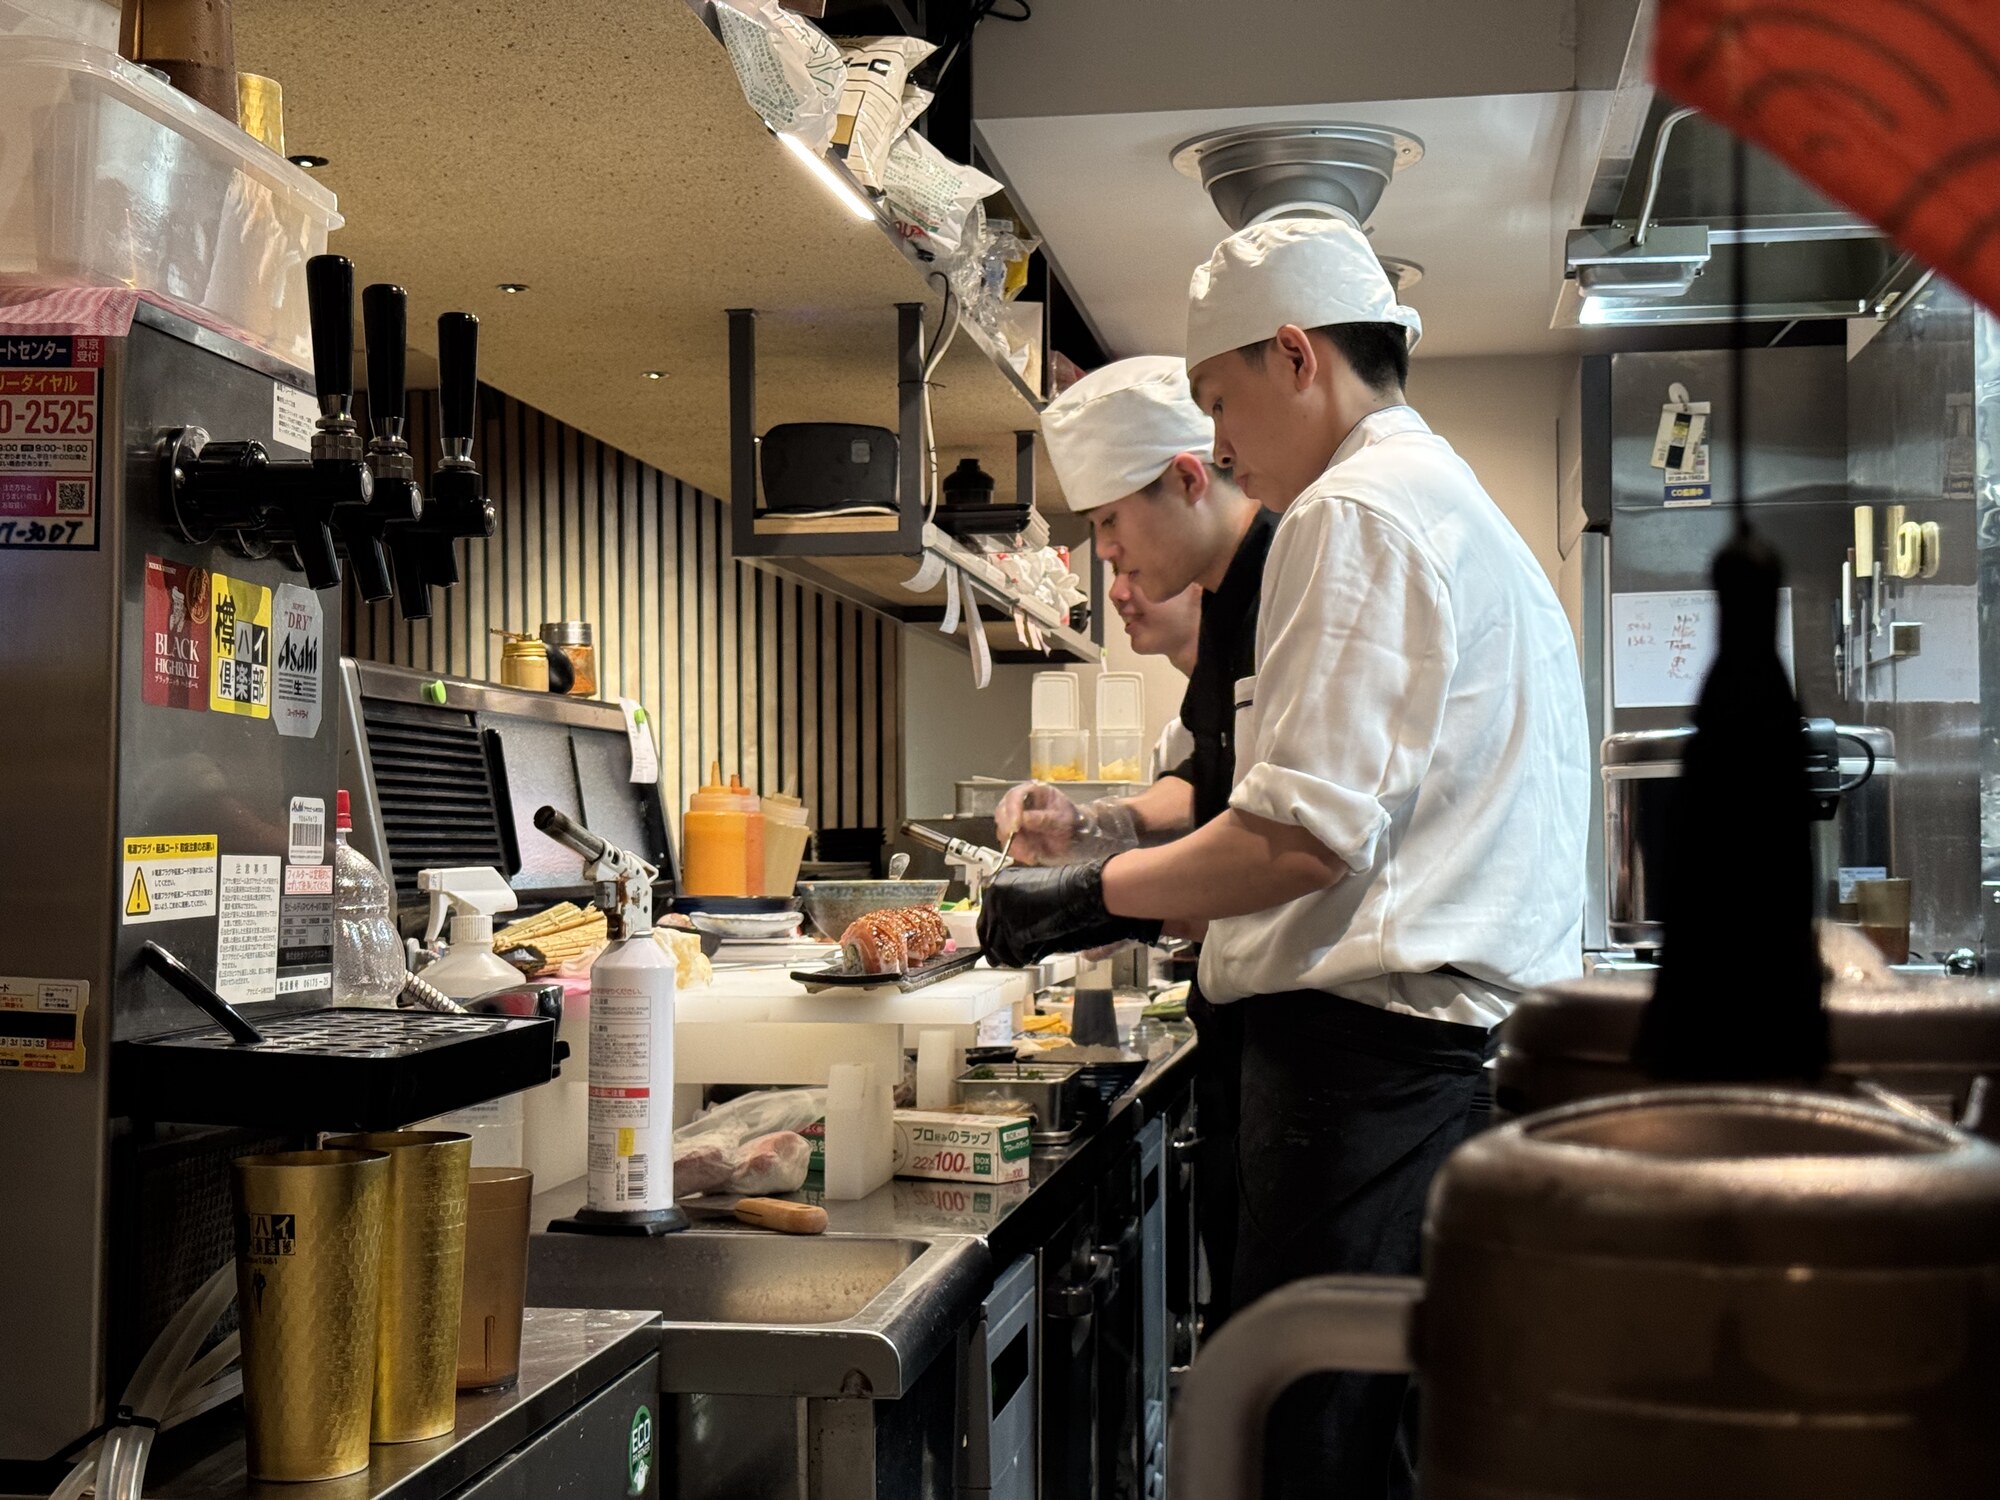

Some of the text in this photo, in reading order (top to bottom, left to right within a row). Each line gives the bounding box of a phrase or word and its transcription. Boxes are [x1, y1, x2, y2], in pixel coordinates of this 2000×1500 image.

[77, 338, 99, 349] 東京
[77, 350, 99, 362] 受付
[0, 400, 94, 434] 0-2525
[155, 632, 200, 662] BLACK
[278, 631, 318, 674] Asahi
[155, 657, 200, 679] HIGHBALL
[293, 680, 303, 696] 生
[974, 1156, 991, 1165] BOX
[632, 1418, 651, 1454] ECO
